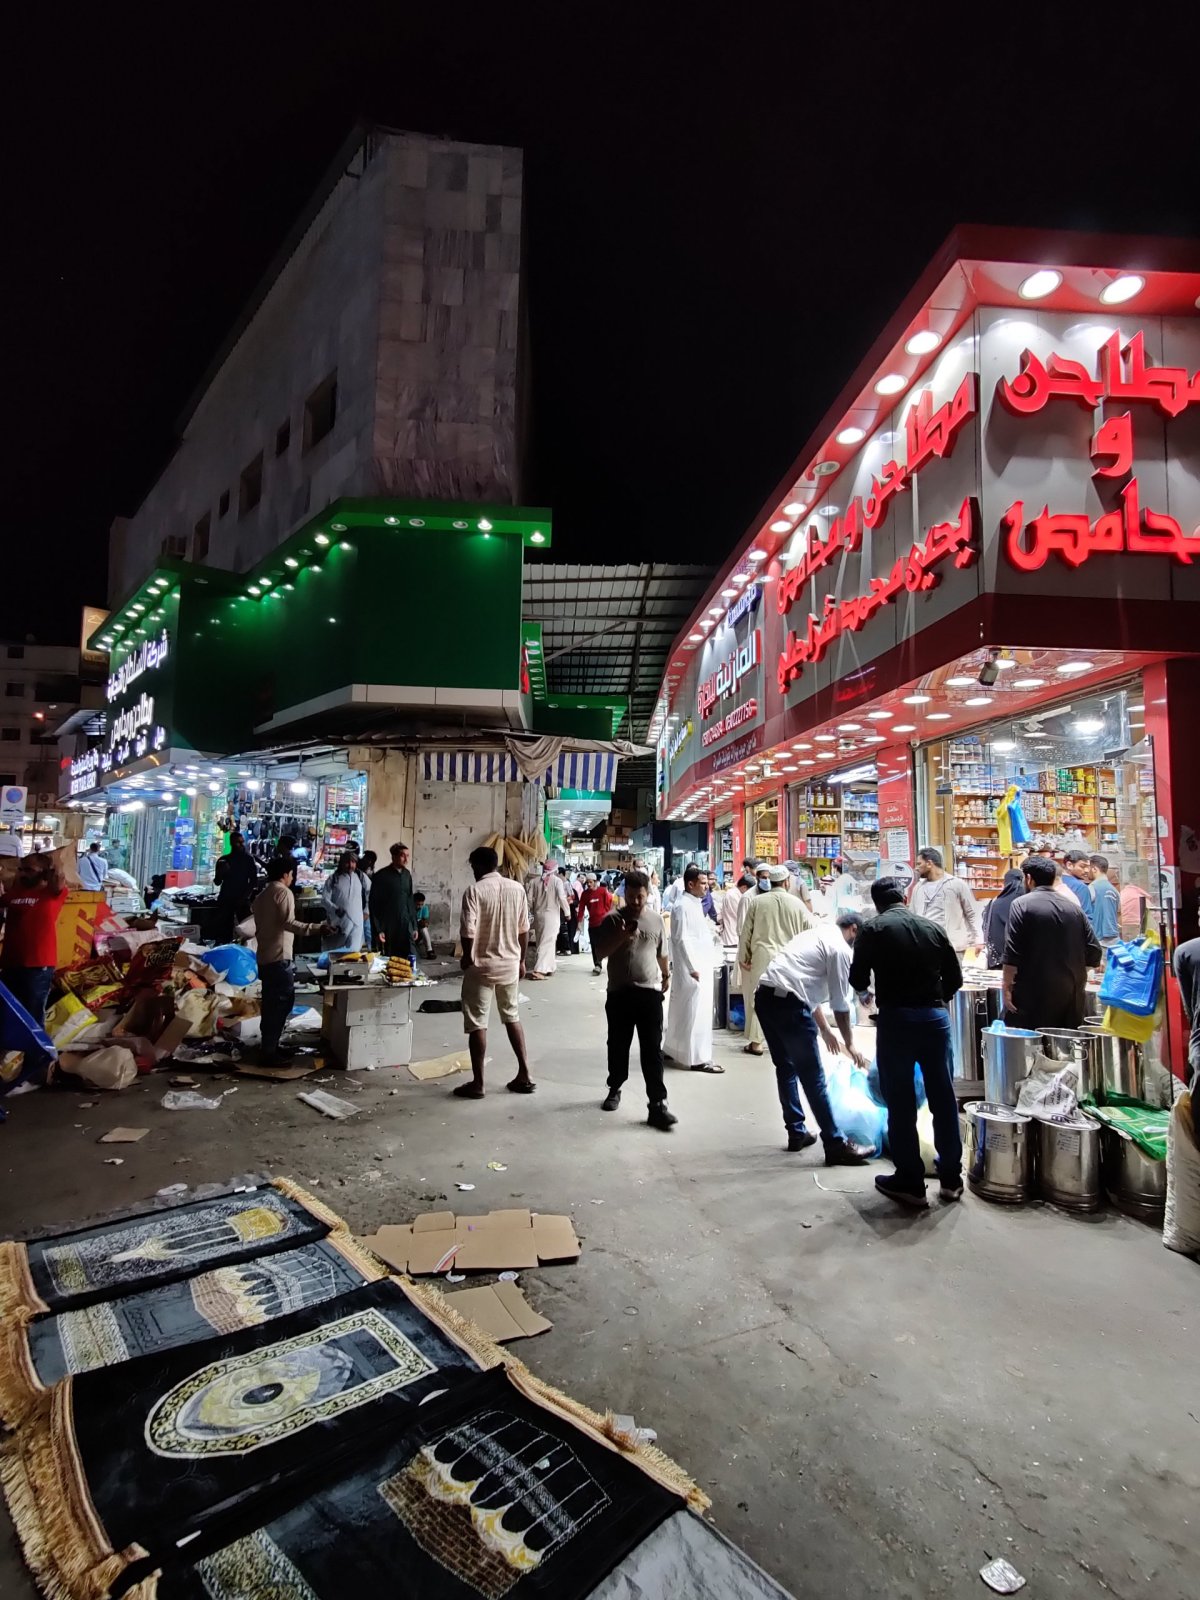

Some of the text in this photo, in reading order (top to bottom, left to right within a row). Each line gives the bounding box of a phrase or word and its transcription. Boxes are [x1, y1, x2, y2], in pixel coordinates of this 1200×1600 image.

[863, 371, 980, 529] مطاحن
[1090, 411, 1134, 478] و
[1003, 476, 1200, 572] حامص
[840, 556, 907, 632] محمد
[146, 628, 168, 669] شركة
